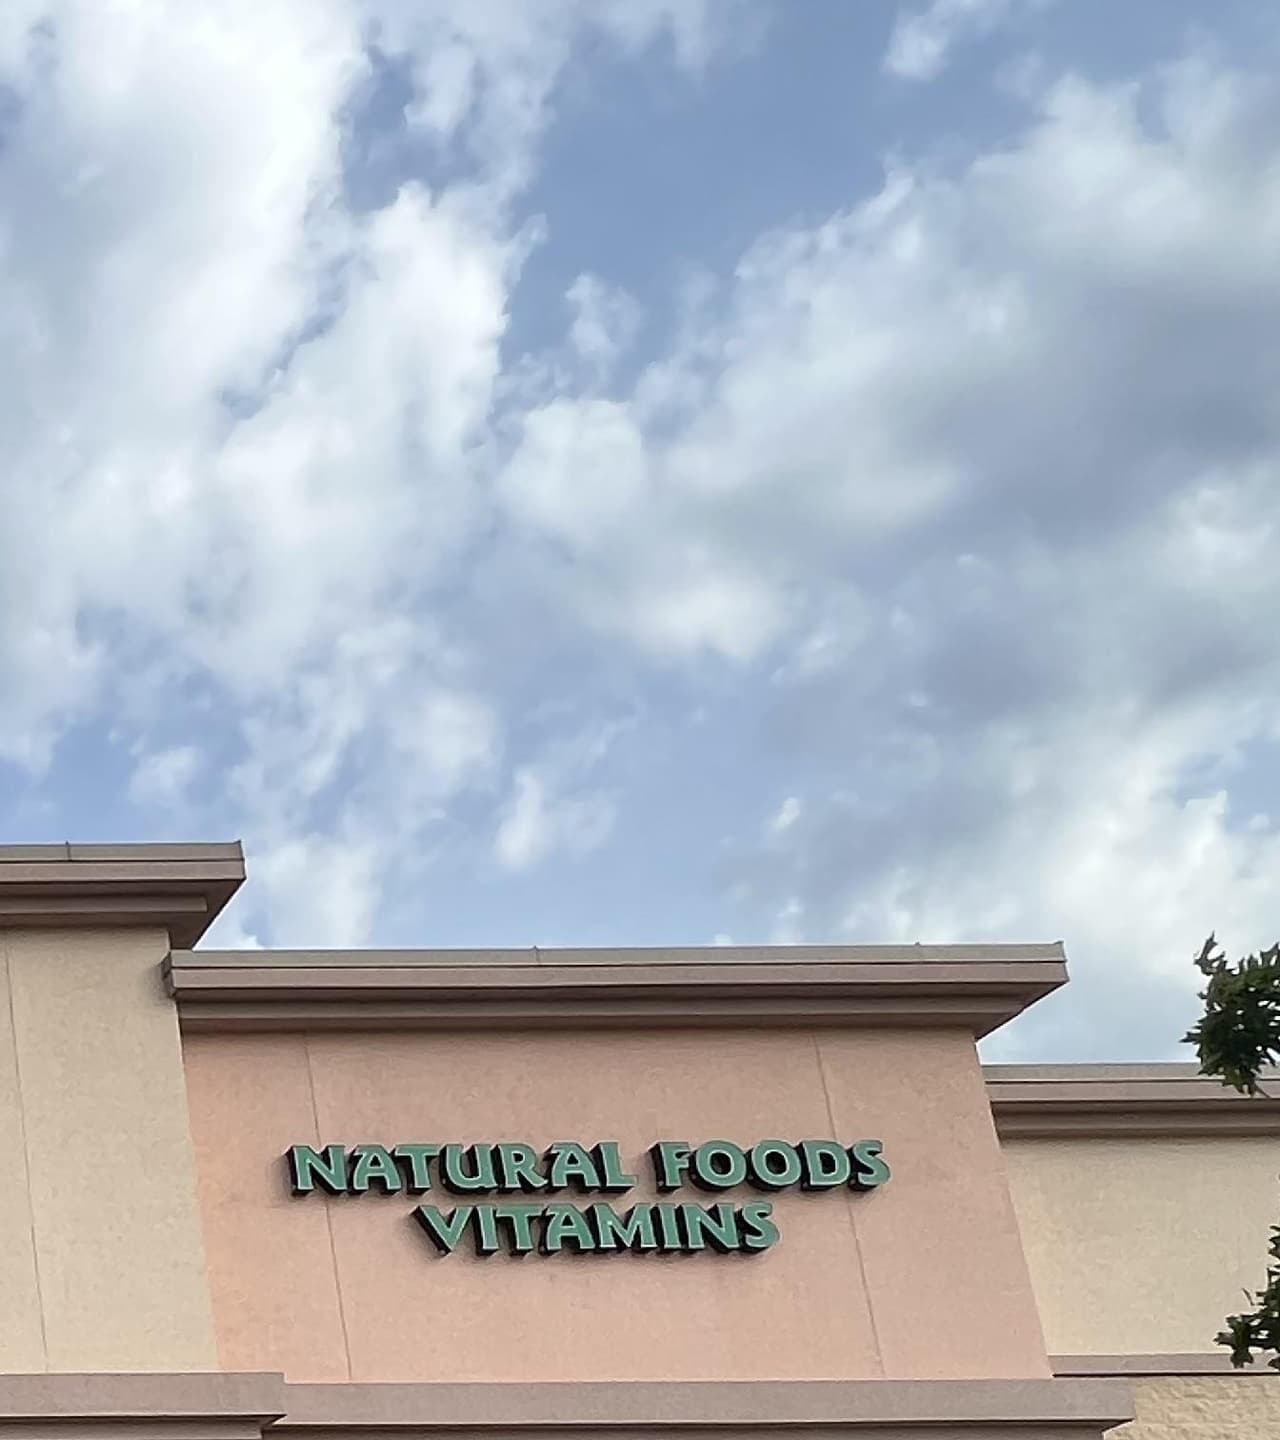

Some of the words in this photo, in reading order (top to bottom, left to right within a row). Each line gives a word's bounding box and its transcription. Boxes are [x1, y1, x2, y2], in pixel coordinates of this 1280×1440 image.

[287, 1140, 638, 1196] NATURAL
[649, 1139, 893, 1194] FOODS
[412, 1200, 782, 1256] VITAMINS
